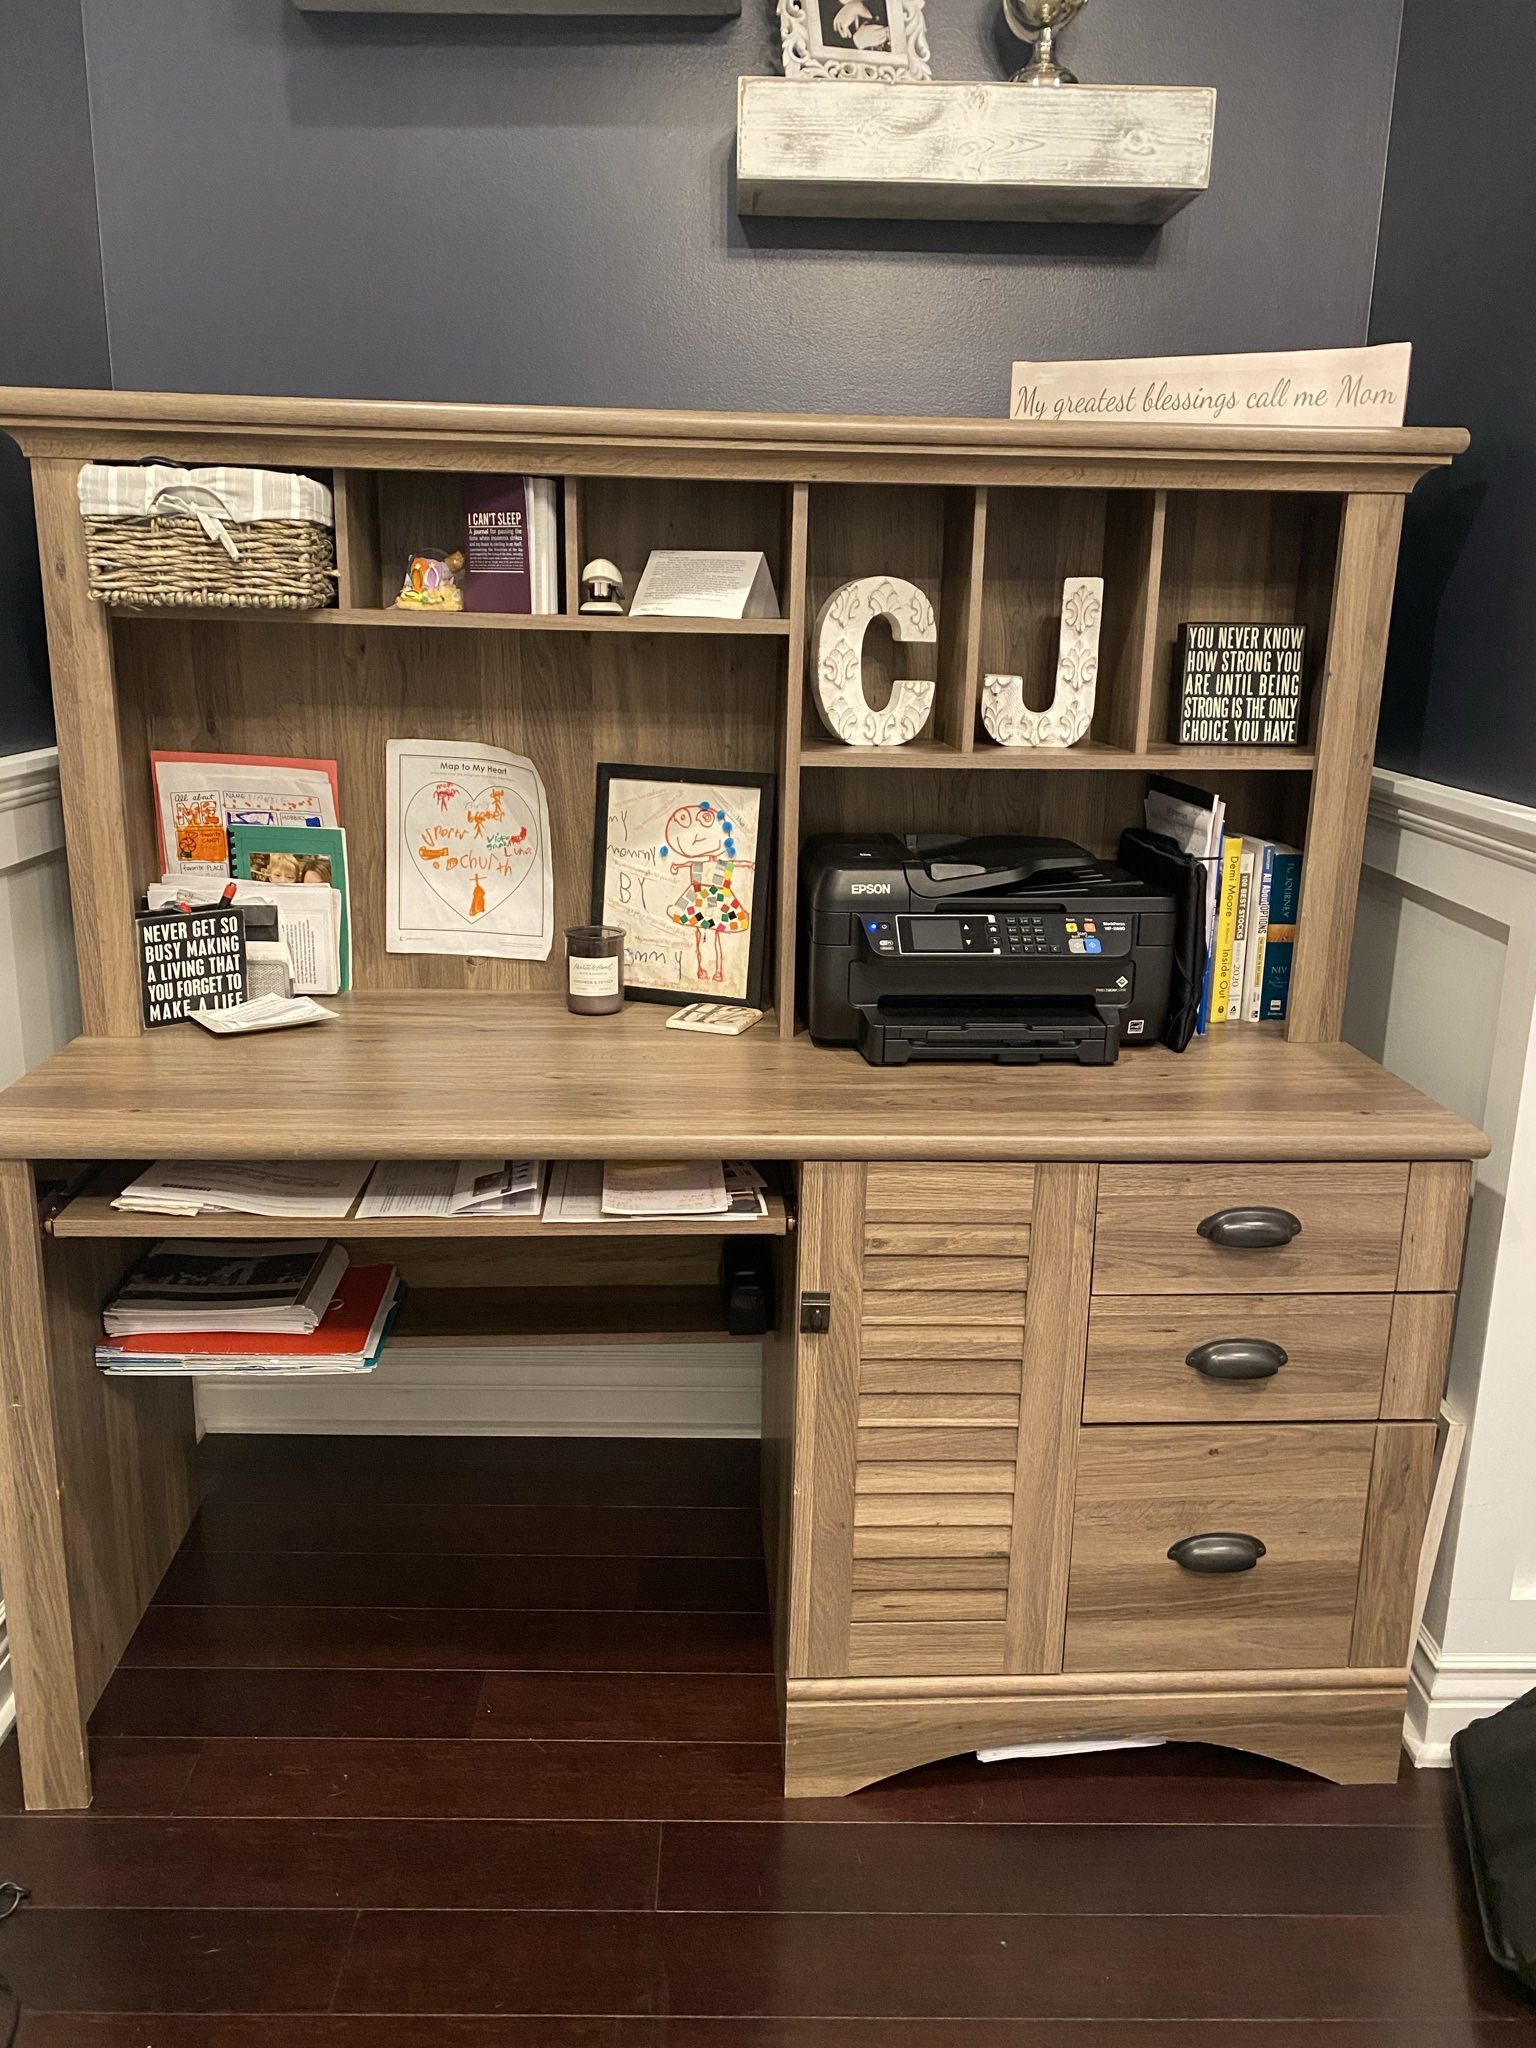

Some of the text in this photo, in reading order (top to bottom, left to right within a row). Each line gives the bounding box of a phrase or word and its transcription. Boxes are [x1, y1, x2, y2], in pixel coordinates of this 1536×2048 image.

[1014, 374, 1397, 420] My greatest blessings call me Mom
[468, 512, 521, 525] I CAN'T SLEEP
[1190, 627, 1304, 649] YOU NEVER KNOW
[811, 576, 937, 746] C
[981, 577, 1104, 748] J
[1187, 651, 1301, 672] HOW STRONG YOU
[1185, 674, 1299, 696] ARE UNTIL BEING
[1184, 697, 1297, 719] STRONG IS THE ONLY
[1183, 720, 1296, 741] CHOICE YOU HAVE
[440, 762, 459, 771] Map
[472, 764, 485, 773] My
[487, 766, 507, 775] Heart
[175, 793, 188, 802] All
[176, 801, 219, 825] ME
[1229, 856, 1239, 881] Demi
[1263, 873, 1272, 882] All
[620, 872, 648, 911] BY
[851, 883, 891, 895] EPSON
[1241, 875, 1249, 886] 100
[1226, 885, 1236, 916] Moore
[1239, 889, 1248, 908] BEST
[1261, 885, 1271, 905] About
[1282, 876, 1293, 917] JOURNEY
[143, 916, 238, 943] NEVER GET SO
[1236, 908, 1245, 939] STOCKS
[1258, 905, 1270, 934] OPTIONS
[145, 935, 240, 963] BUSY MAKING
[147, 954, 240, 983] A LIVING THAT
[1220, 949, 1230, 977] Inside
[1271, 966, 1287, 974] NIV
[1232, 964, 1240, 987] 2020
[147, 973, 242, 1002] YOU FORGET TO
[1218, 980, 1228, 998] Out
[149, 999, 191, 1022] MAKE
[199, 997, 207, 1011] A
